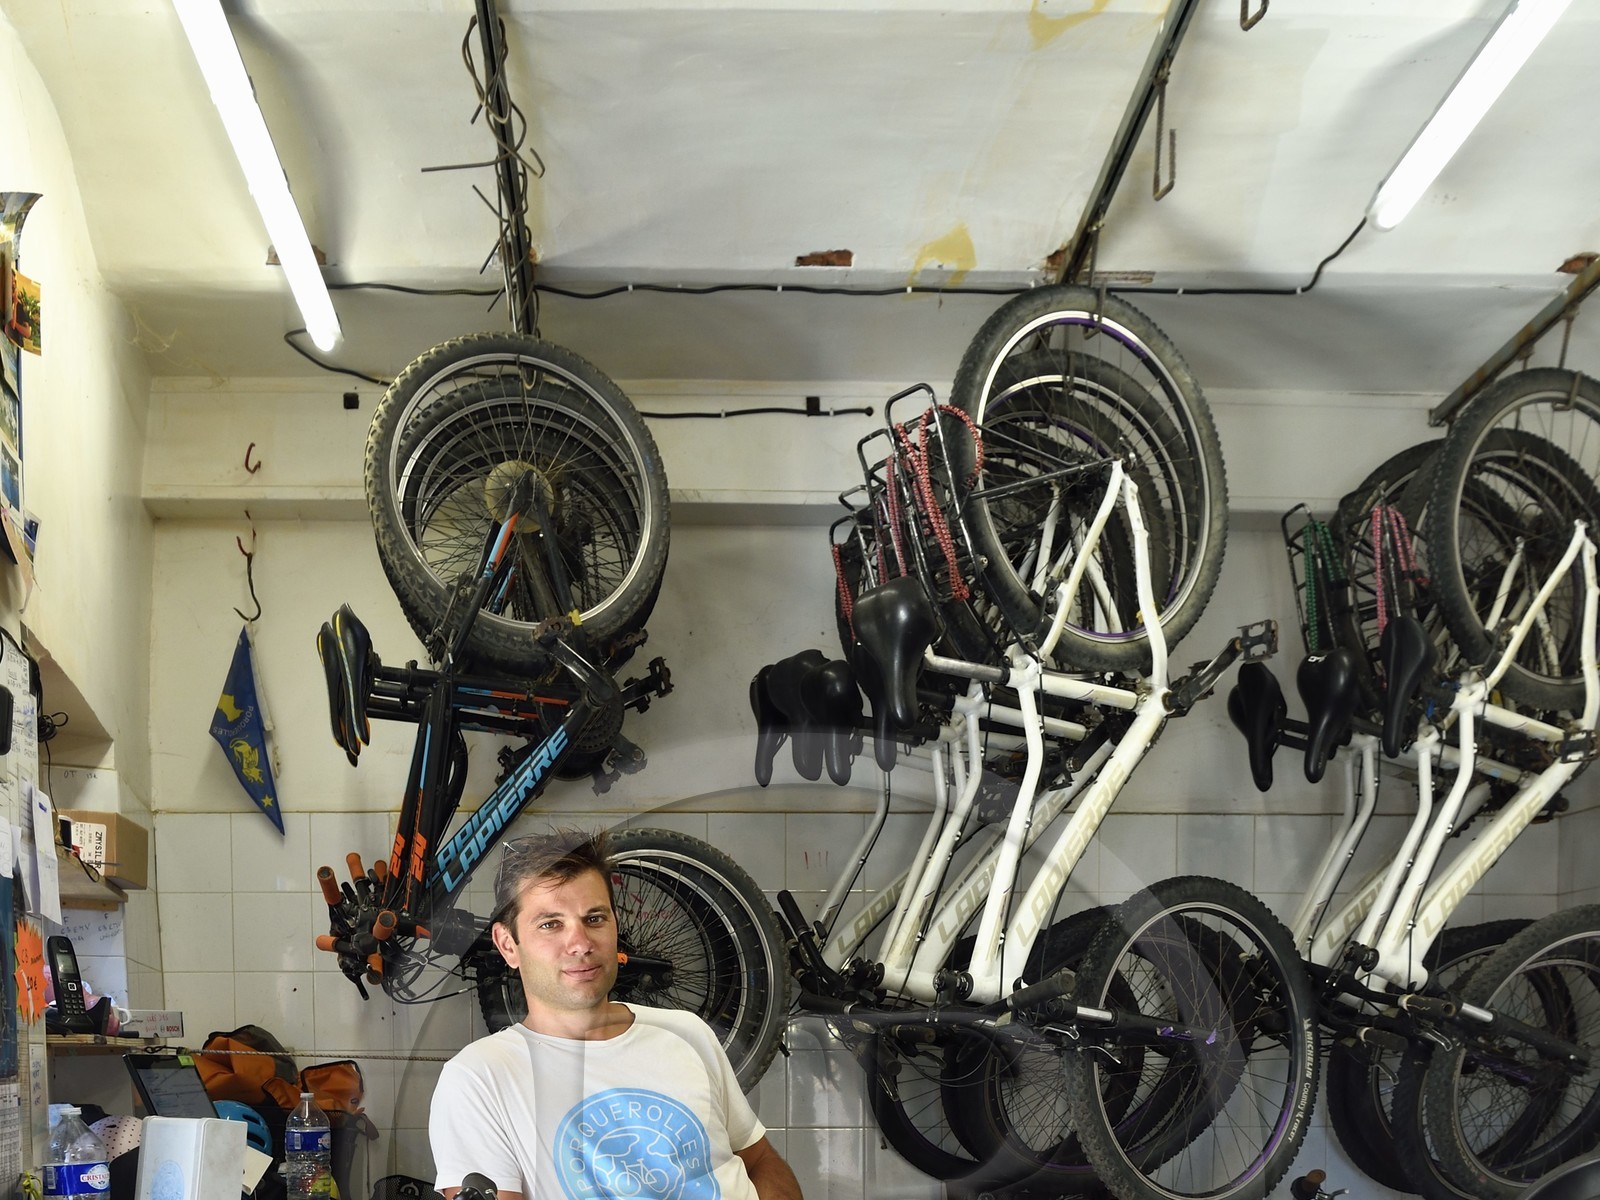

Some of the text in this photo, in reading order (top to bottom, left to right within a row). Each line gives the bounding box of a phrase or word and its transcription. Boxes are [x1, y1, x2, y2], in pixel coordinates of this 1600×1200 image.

[442, 724, 569, 892] LAPIERRE
[1015, 762, 1125, 947] LAPIERRE
[1422, 791, 1543, 940] LAPIERRE
[165, 1025, 181, 1033] BOSCH
[1304, 1030, 1315, 1080] MICHELIN
[1296, 1081, 1312, 1111] Country
[569, 1100, 701, 1194] PORQUEROLLES
